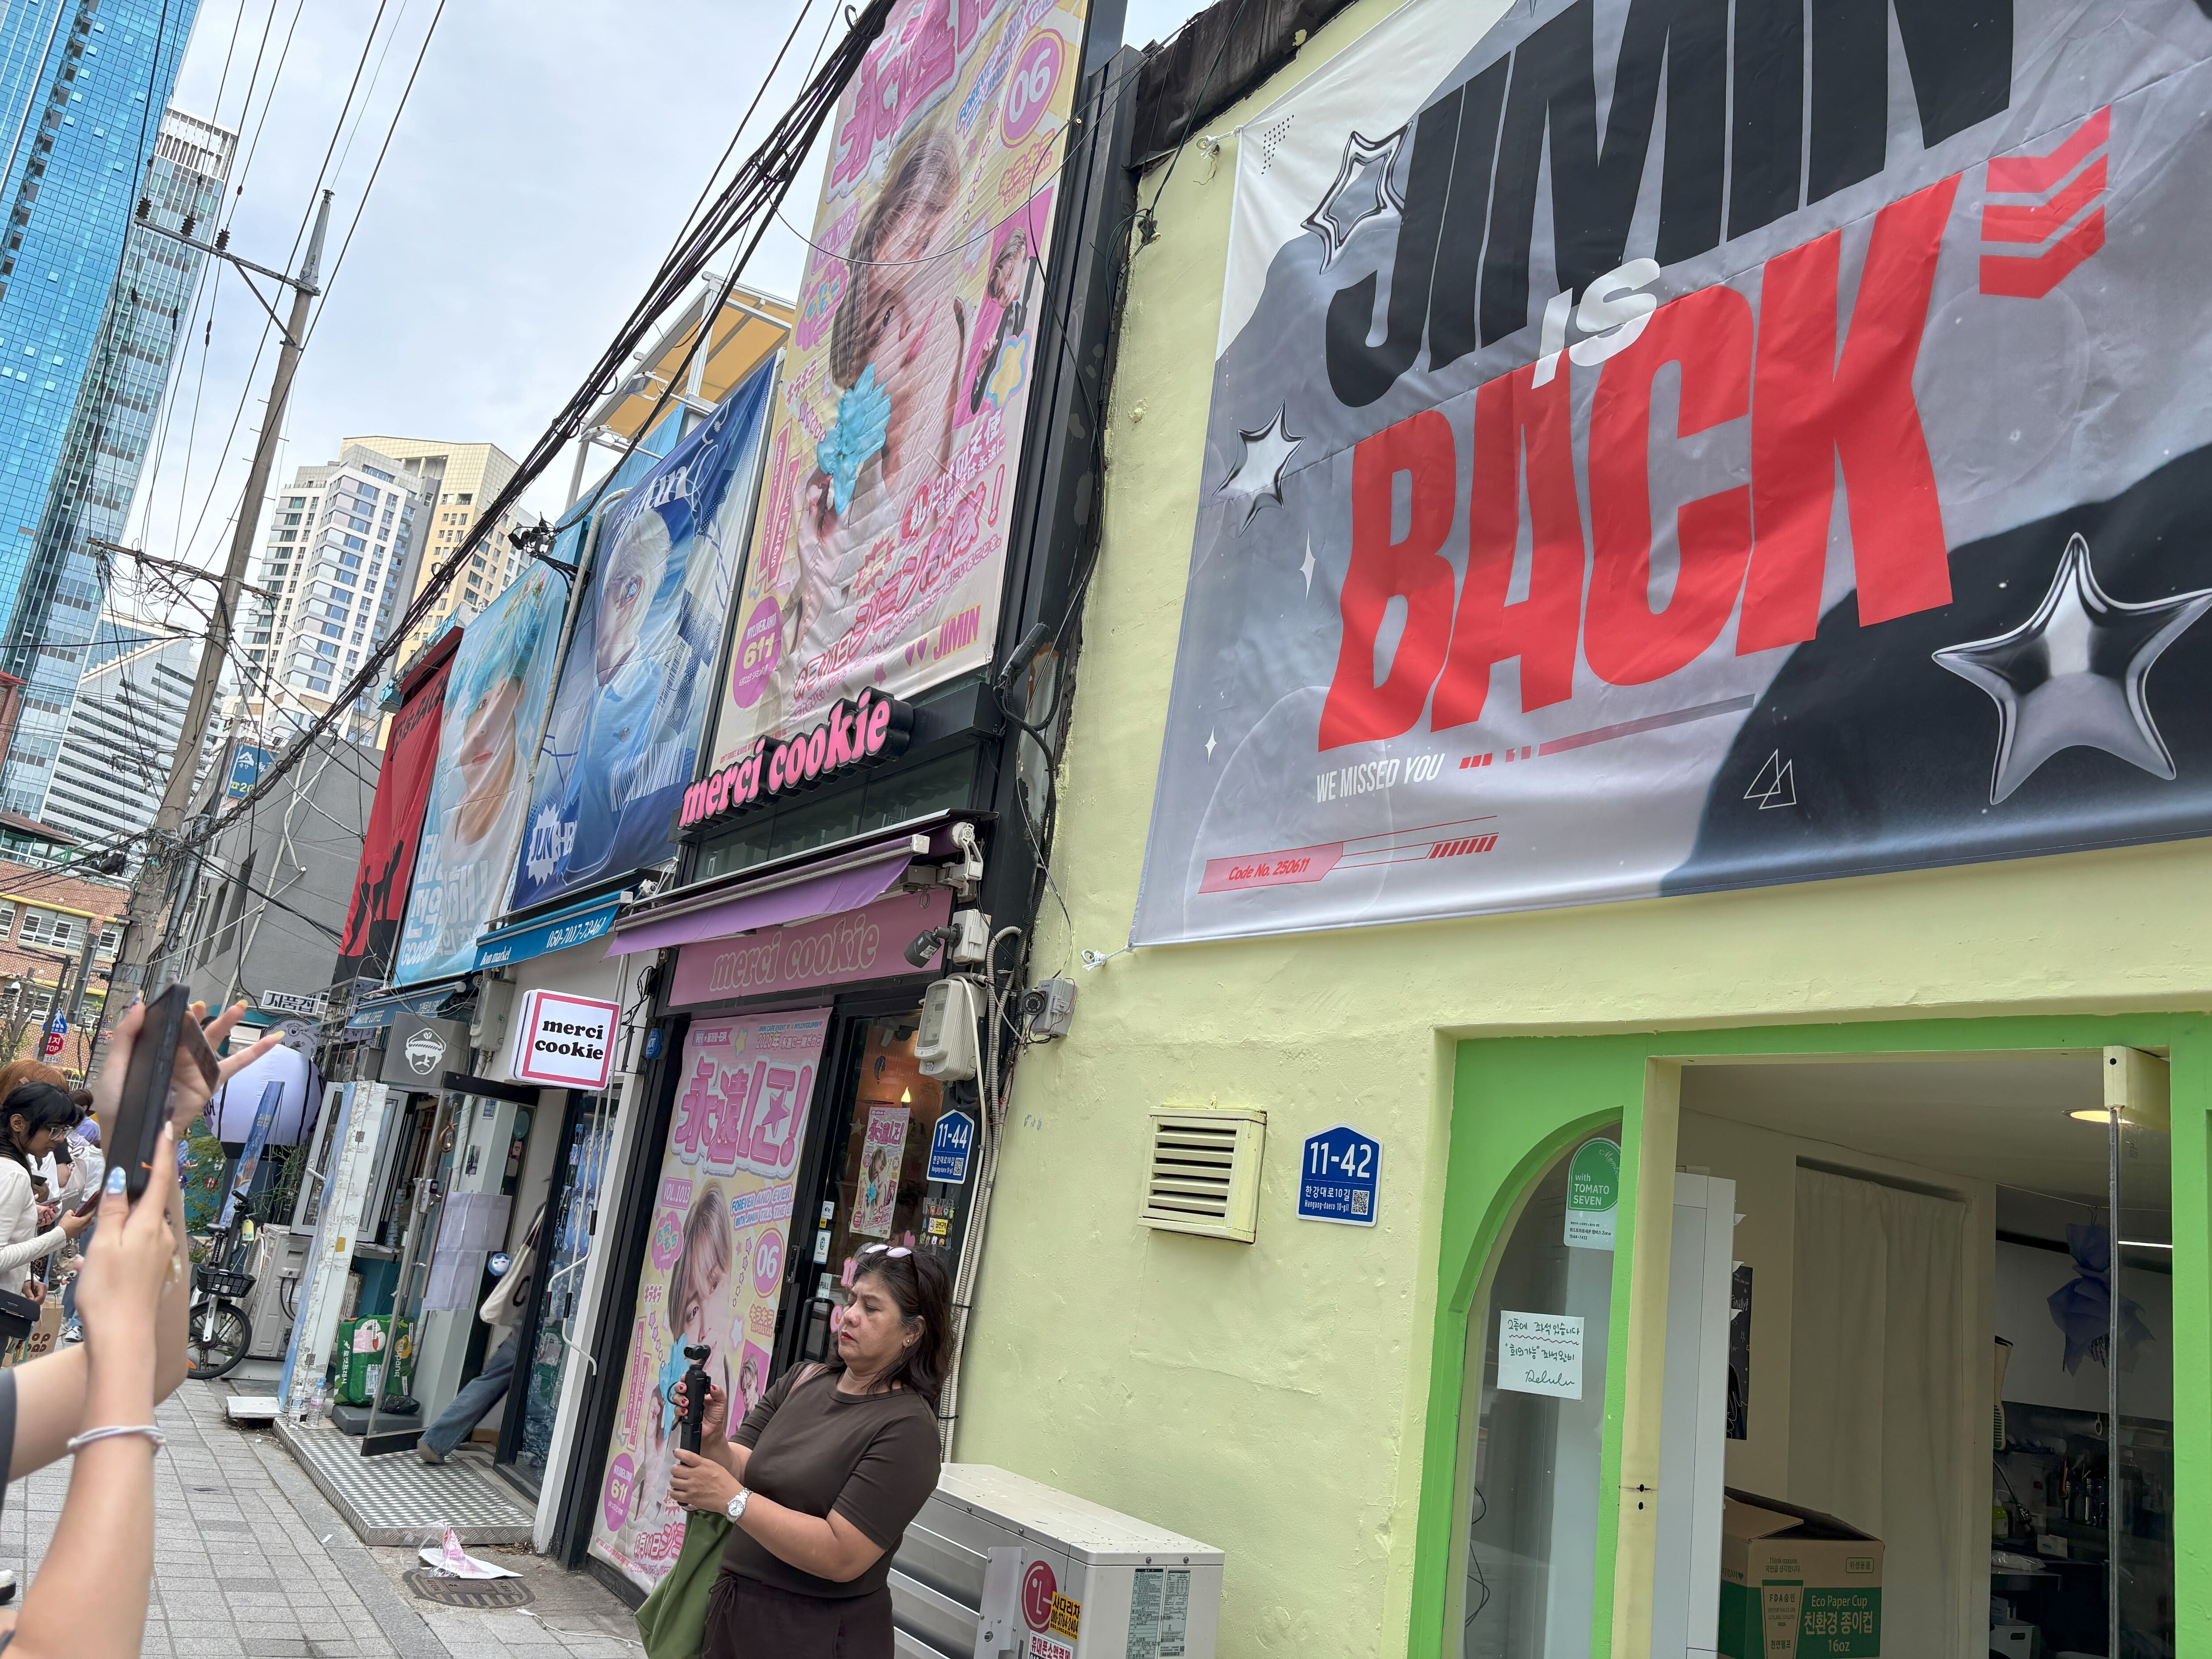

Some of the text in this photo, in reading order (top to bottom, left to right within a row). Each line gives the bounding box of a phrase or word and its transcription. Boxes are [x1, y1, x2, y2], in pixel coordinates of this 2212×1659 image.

[1009, 48, 1051, 123] 06
[1318, 172, 1953, 752] BACK
[933, 604, 981, 661] JIMIN
[743, 632, 775, 669] 611
[678, 687, 890, 827] merci cookie
[1317, 753, 1445, 803] WE MISSED YOU
[1229, 856, 1311, 880] Code No. 250611
[710, 914, 879, 991] merci cookie
[542, 1020, 604, 1040] merci
[535, 1040, 604, 1060] cookie
[756, 1033, 780, 1049] 2025年
[937, 1123, 968, 1149] 11-44
[933, 1156, 955, 1166] 한강대로10길
[1310, 1142, 1371, 1178] 11-42
[732, 1186, 791, 1212] FOREVER AND EVER
[1306, 1185, 1350, 1201] 한강대로10길
[1575, 1183, 1609, 1194] TOMATO
[1305, 1199, 1349, 1213] Hangang-daero 10-gil
[1574, 1195, 1601, 1206] SEVEN
[761, 1208, 772, 1220] TILL
[774, 1206, 785, 1217] THE
[757, 1244, 779, 1279] 06
[820, 1281, 829, 1290] PULL
[750, 1304, 774, 1325] キラキラ
[1508, 1318, 1527, 1331] 2층에
[751, 1324, 773, 1337] SUPERSTAR
[611, 1479, 629, 1504] 611
[1850, 1561, 1871, 1570] 위생용품
[1053, 1595, 1080, 1619] 사다리차
[1812, 1595, 1867, 1609] Eco Paper Cup
[1804, 1611, 1837, 1635] 친환경
[1840, 1610, 1873, 1634] 종이컵
[1828, 1640, 1850, 1652] 16oz
